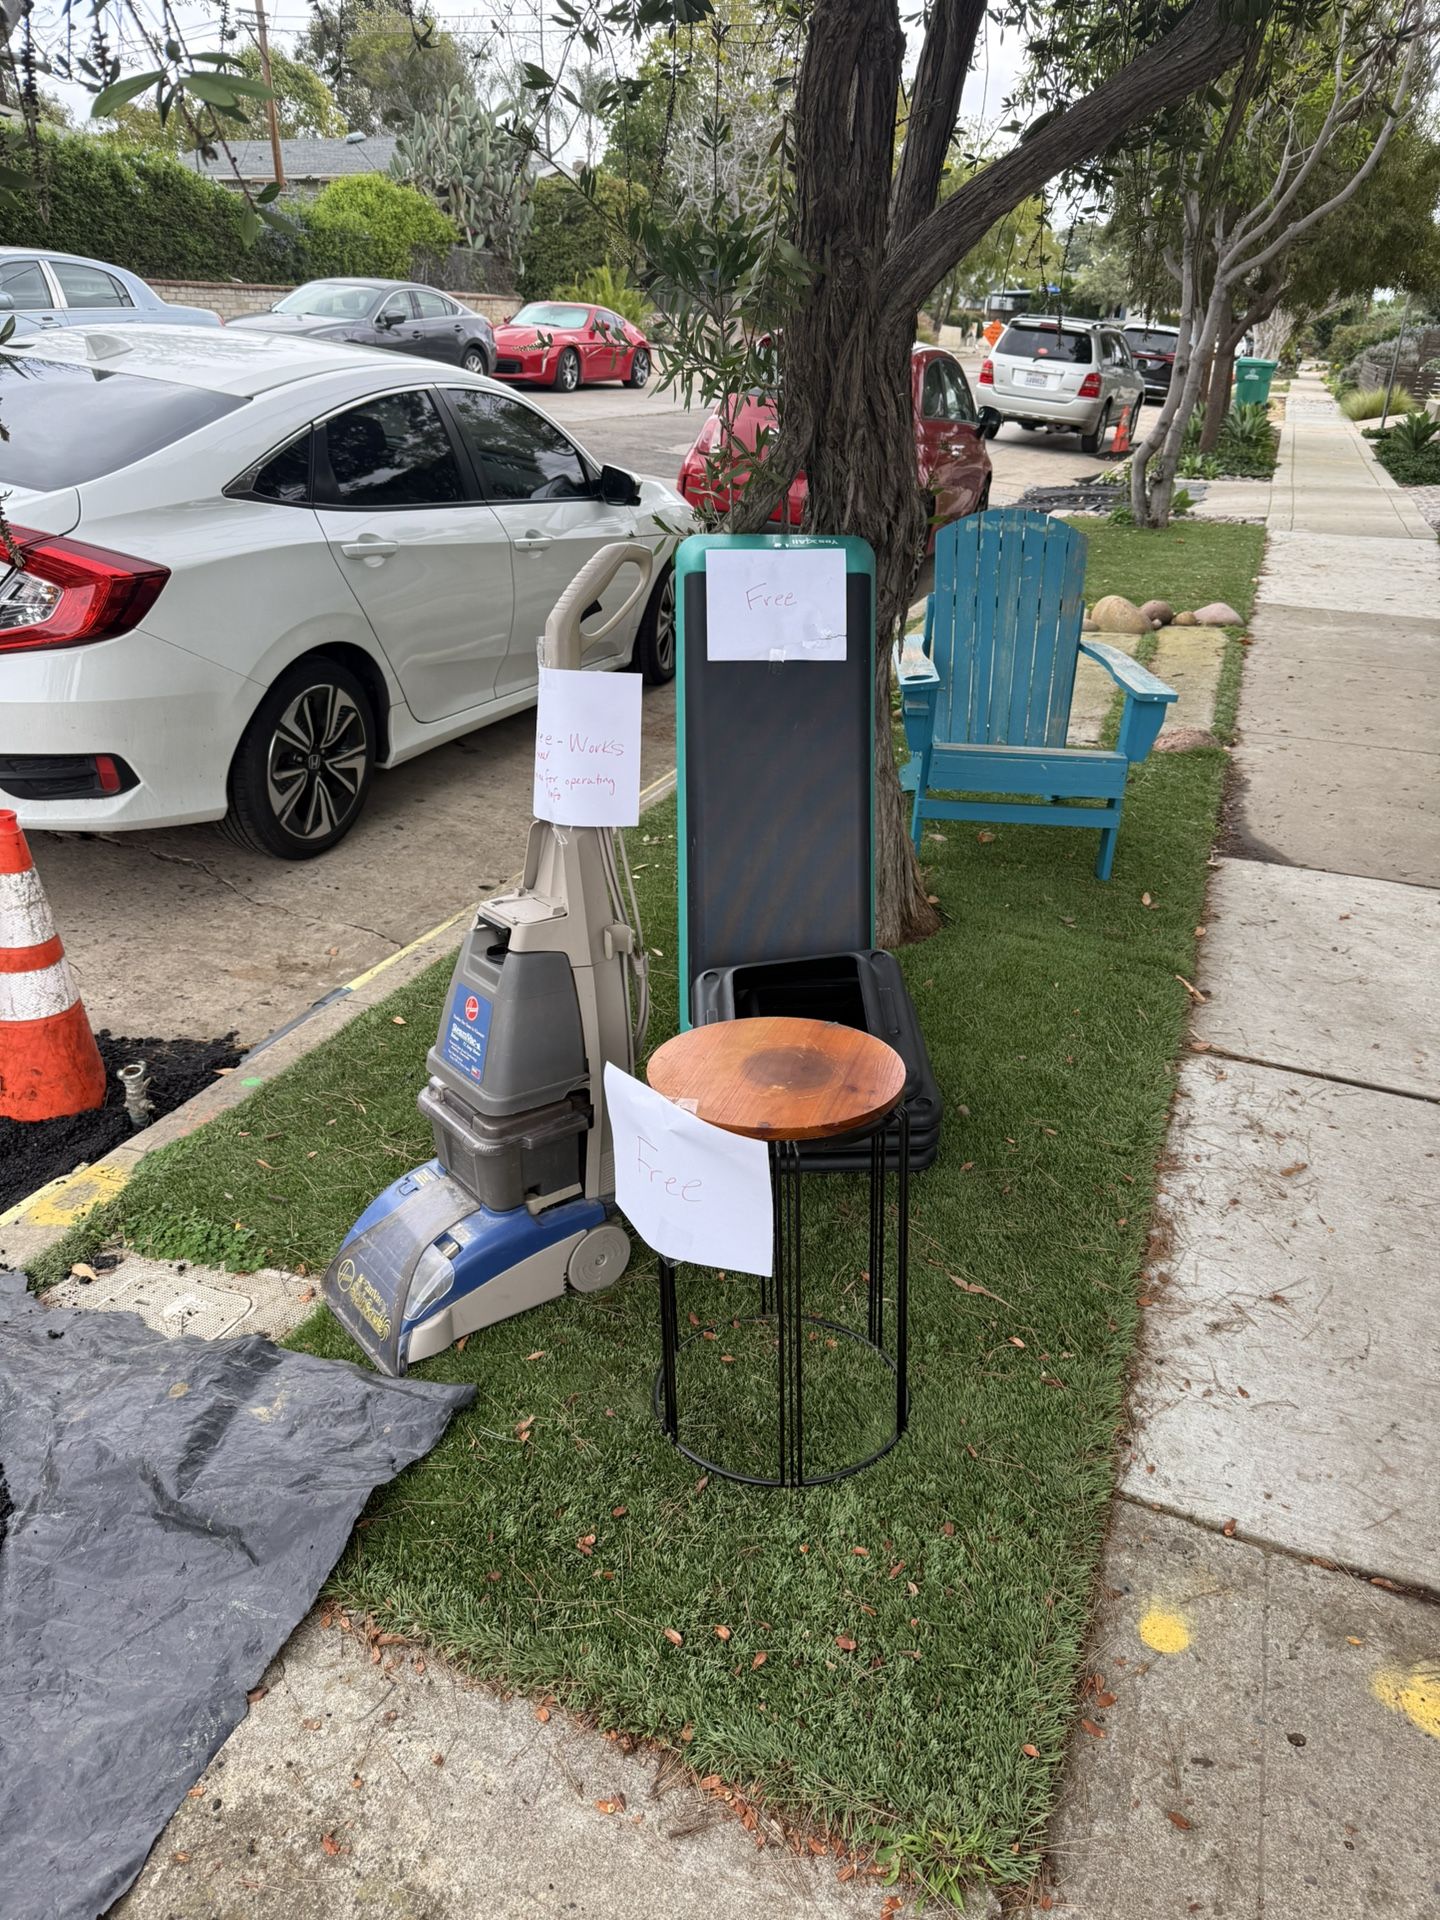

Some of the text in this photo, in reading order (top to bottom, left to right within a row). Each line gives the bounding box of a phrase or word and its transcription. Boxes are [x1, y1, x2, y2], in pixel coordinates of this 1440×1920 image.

[745, 582, 797, 610] Free
[569, 733, 624, 757] Works
[565, 774, 616, 796] operating
[637, 1135, 703, 1202] Free
